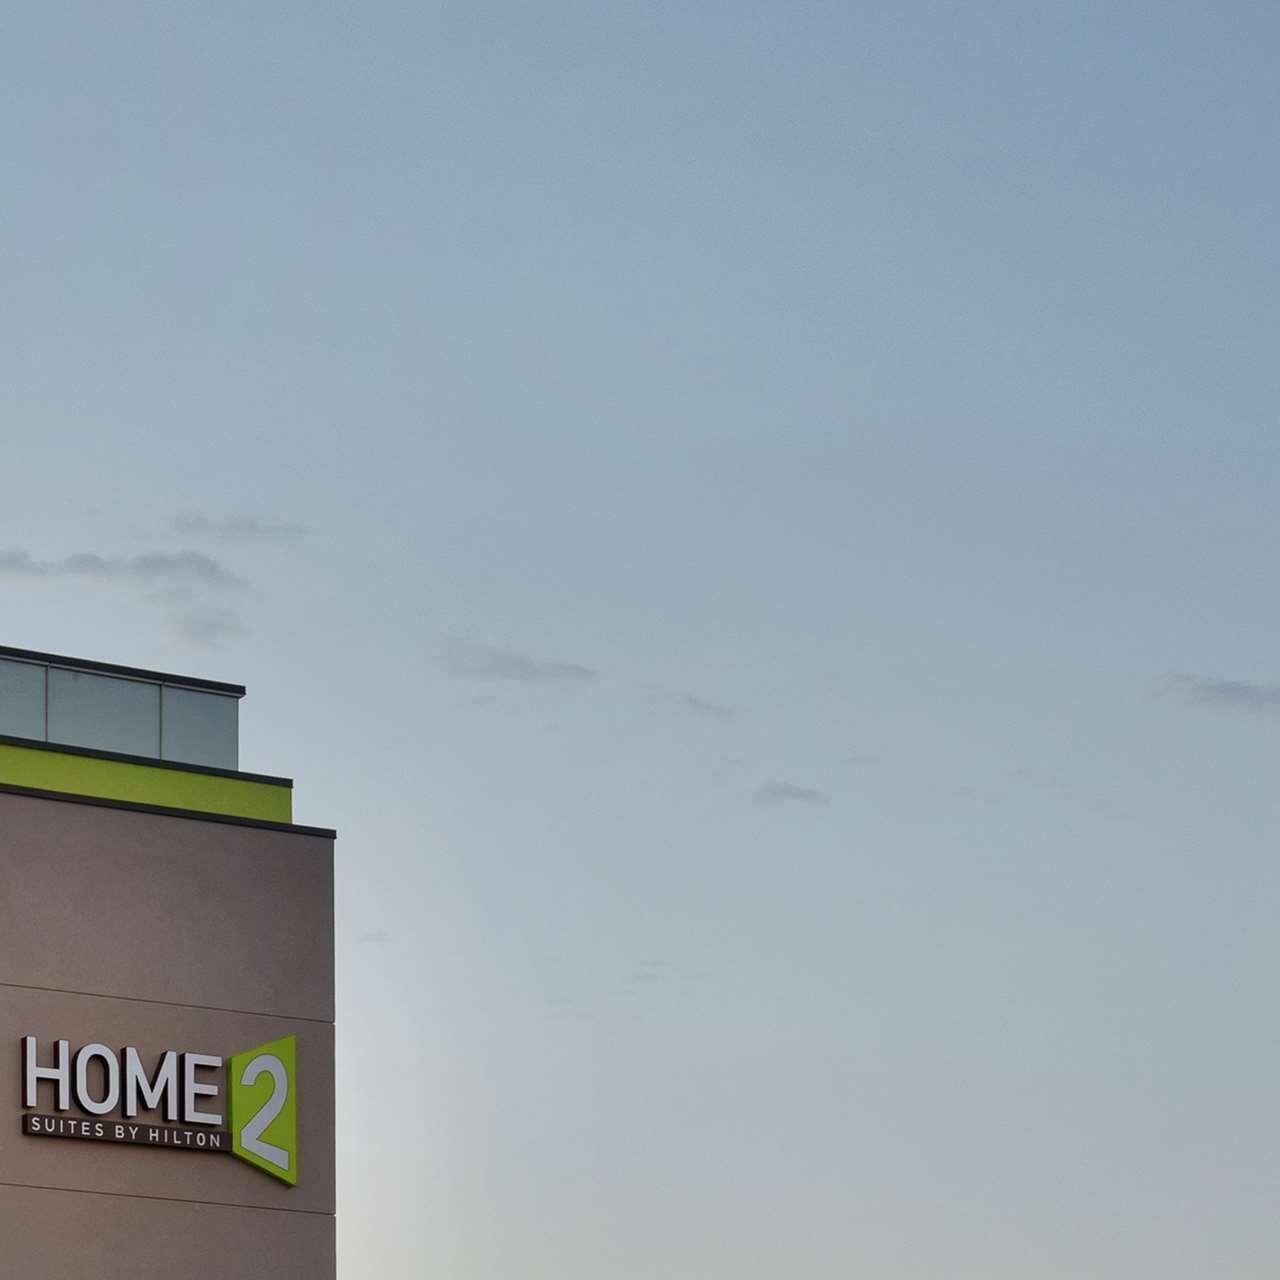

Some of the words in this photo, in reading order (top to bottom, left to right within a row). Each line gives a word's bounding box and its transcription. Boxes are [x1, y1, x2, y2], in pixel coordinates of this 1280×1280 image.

[23, 1036, 222, 1125] HOME
[241, 1054, 289, 1171] 2
[31, 1117, 104, 1137] SUITES
[115, 1125, 139, 1140] BY
[149, 1130, 221, 1148] HILTON
